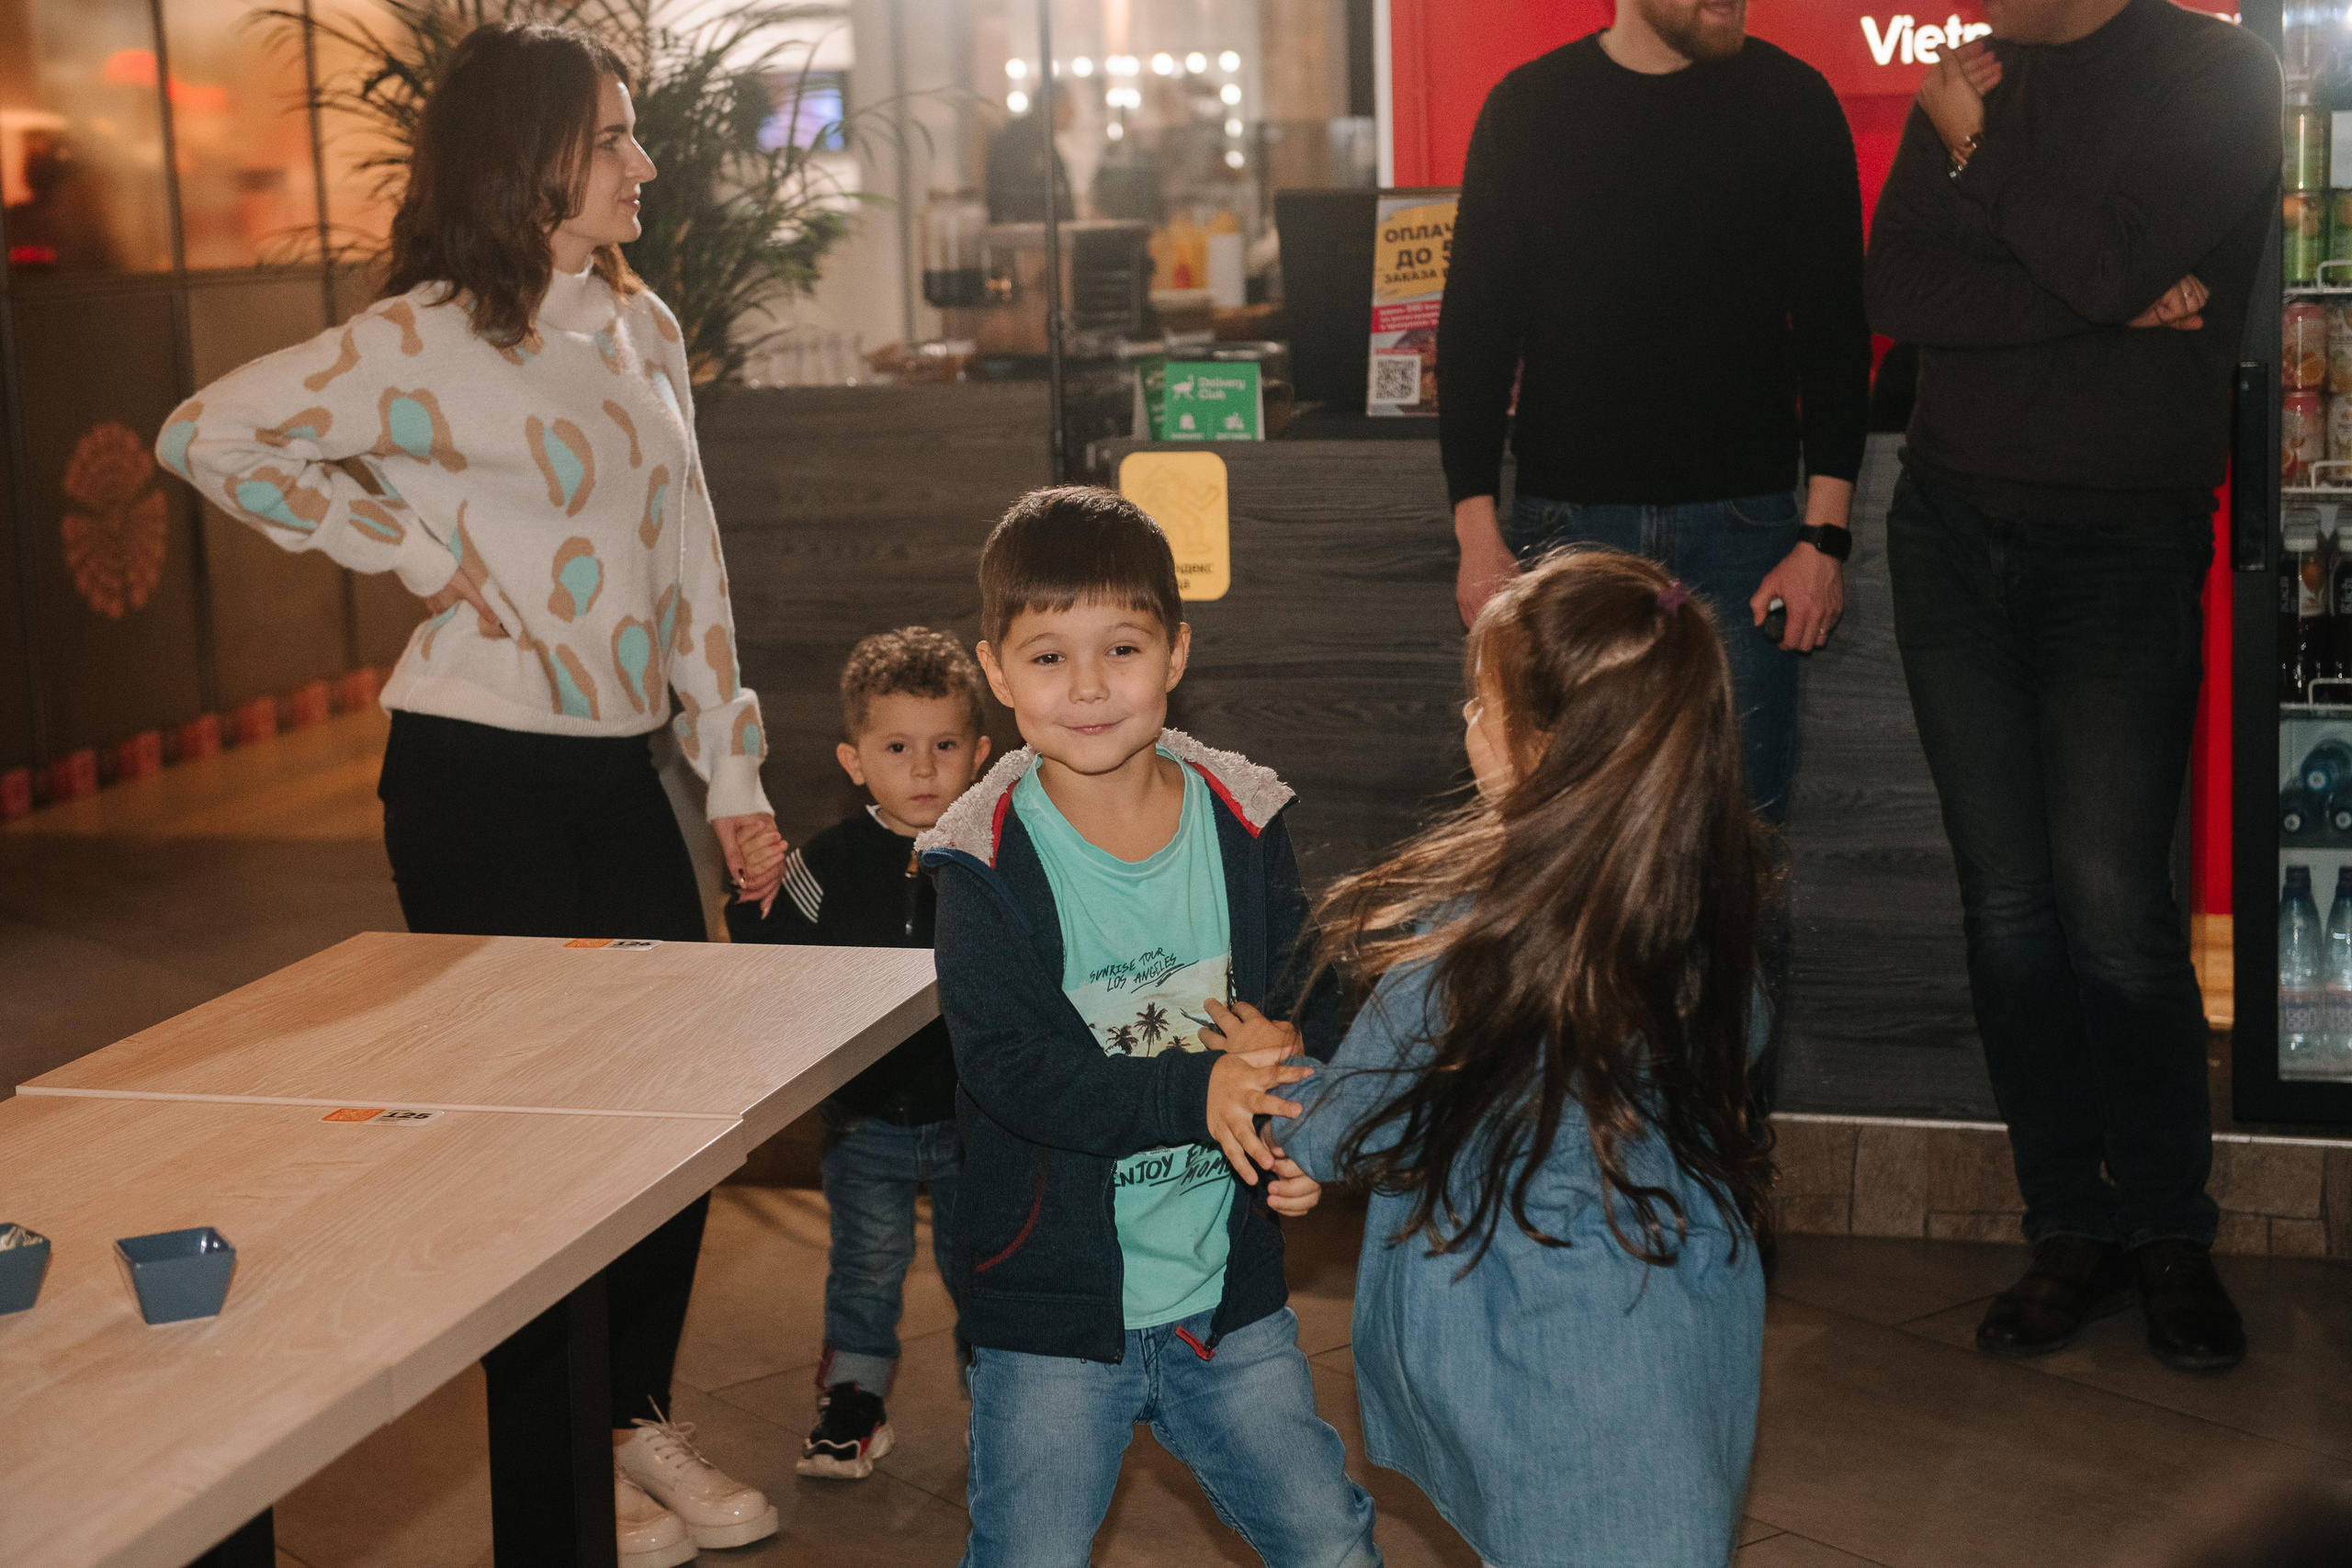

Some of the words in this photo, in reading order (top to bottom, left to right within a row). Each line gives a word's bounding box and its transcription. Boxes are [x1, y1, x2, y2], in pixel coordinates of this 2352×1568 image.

[1396, 248, 1431, 269] ДО
[1385, 269, 1437, 284] ЗАКАЗА
[1198, 377, 1246, 390] Delivery
[1197, 389, 1226, 400] Club
[1090, 958, 1136, 984] SUNRISE
[1138, 947, 1166, 965] TOUR
[1106, 974, 1126, 993] LOS
[1133, 953, 1177, 984] ANGELES
[1181, 1156, 1230, 1186] MOM
